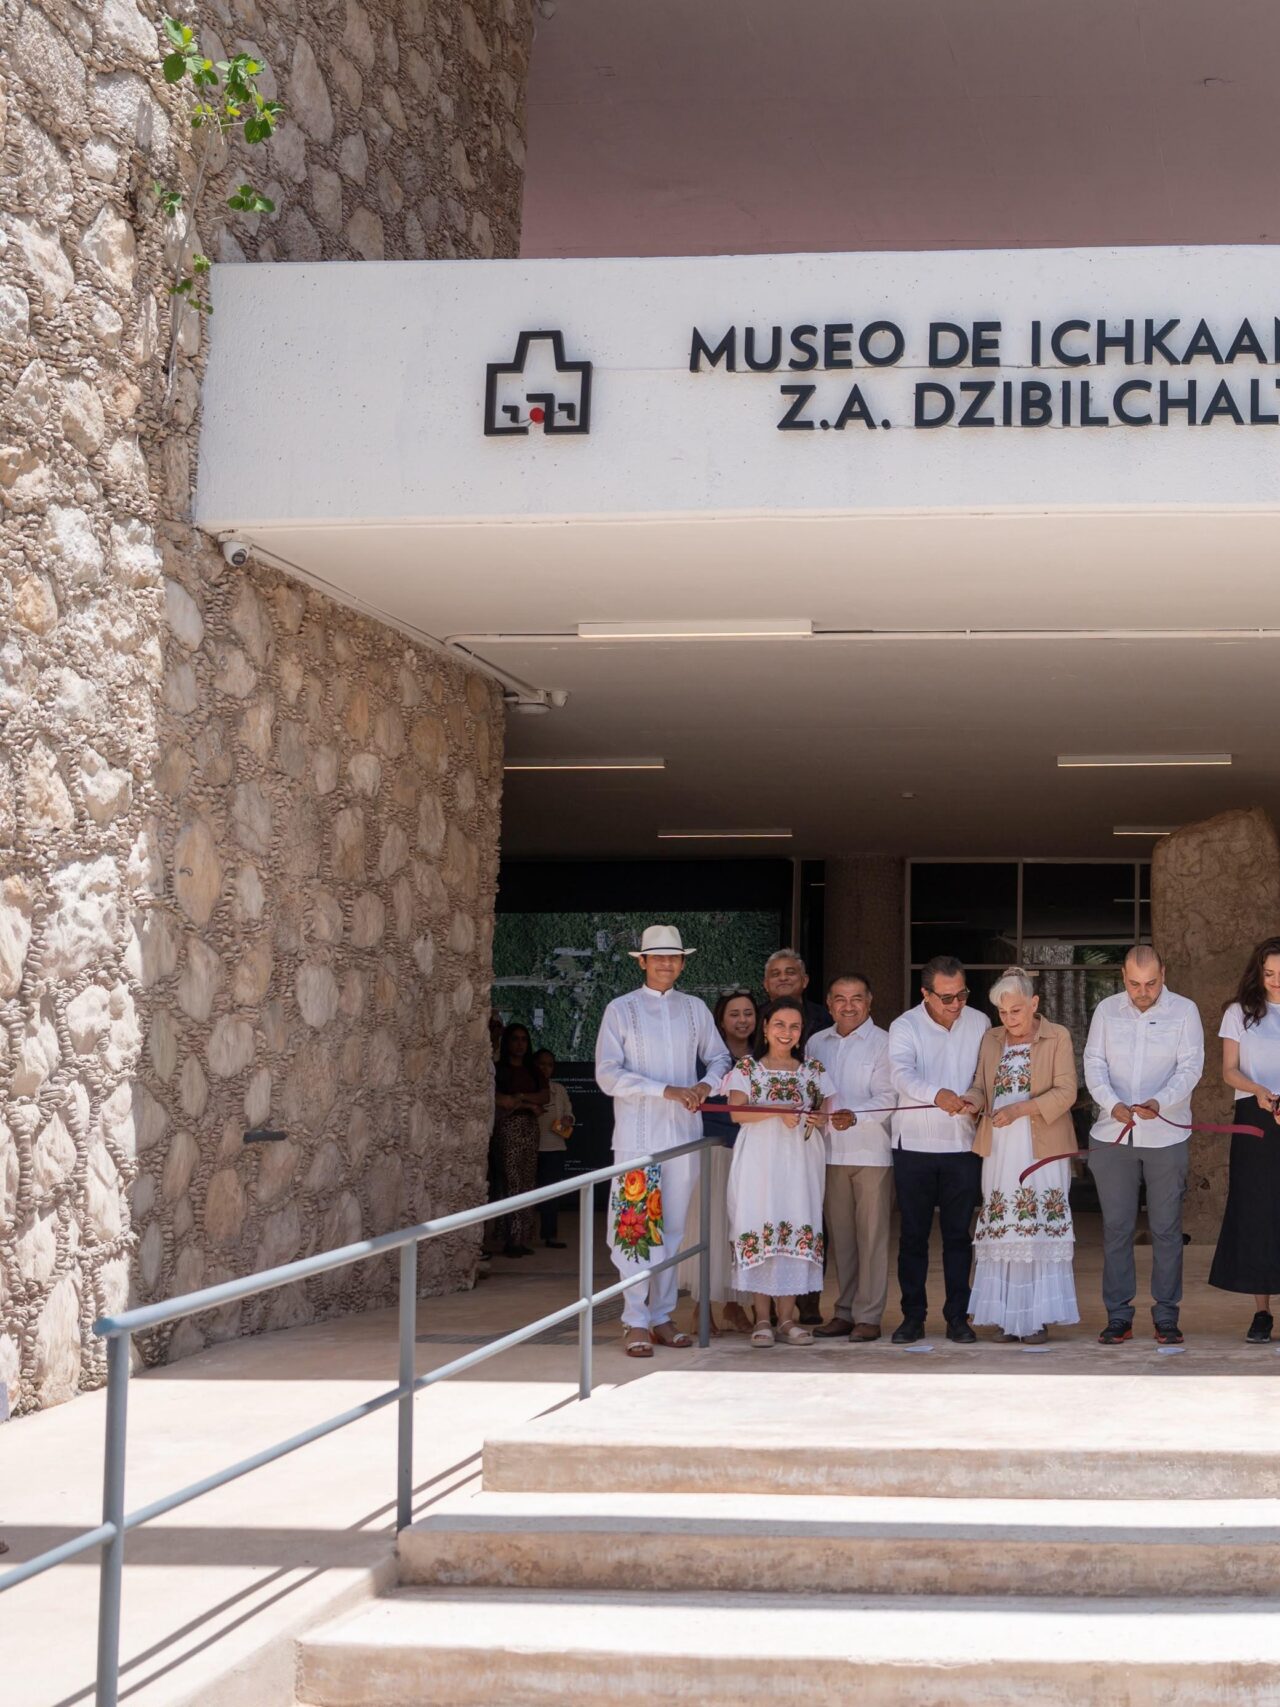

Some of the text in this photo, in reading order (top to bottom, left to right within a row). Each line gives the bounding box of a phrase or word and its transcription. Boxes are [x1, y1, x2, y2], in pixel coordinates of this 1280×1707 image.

[689, 320, 906, 374] MUSEO
[928, 321, 1002, 369] DE
[776, 383, 892, 431] Z.A.
